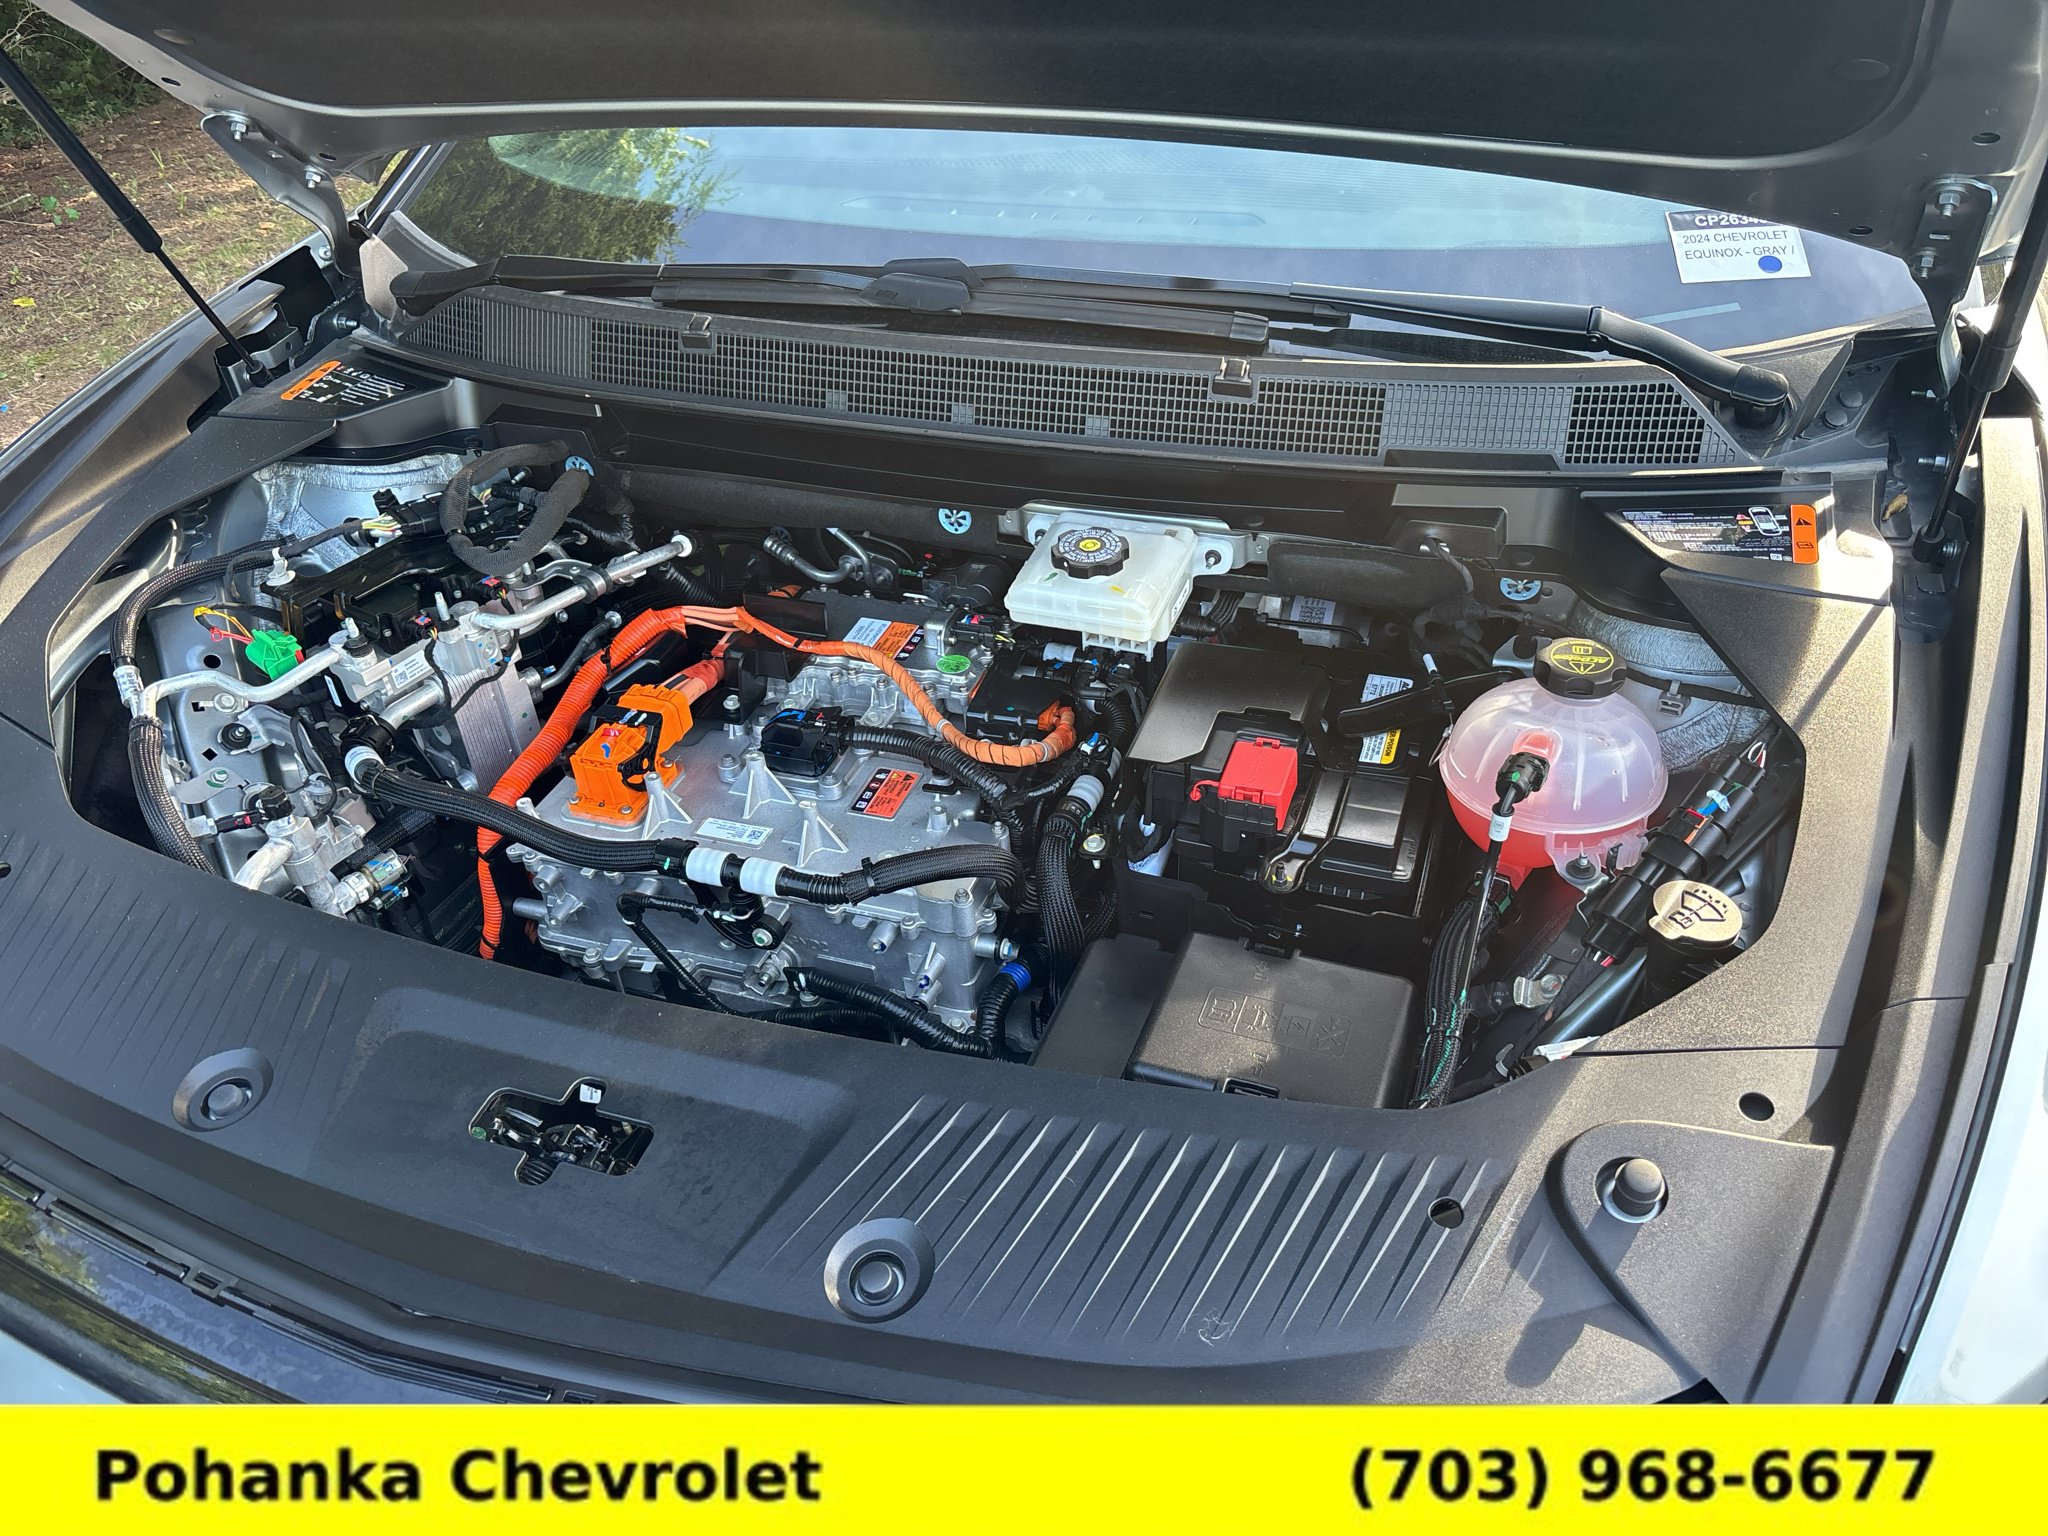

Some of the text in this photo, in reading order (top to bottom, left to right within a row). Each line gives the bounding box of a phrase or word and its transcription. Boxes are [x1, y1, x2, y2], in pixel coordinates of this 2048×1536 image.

[1682, 231, 1788, 244] 2024 CHEVROLET
[1684, 247, 1744, 260] EQUINOX
[1752, 245, 1787, 256] GRAY
